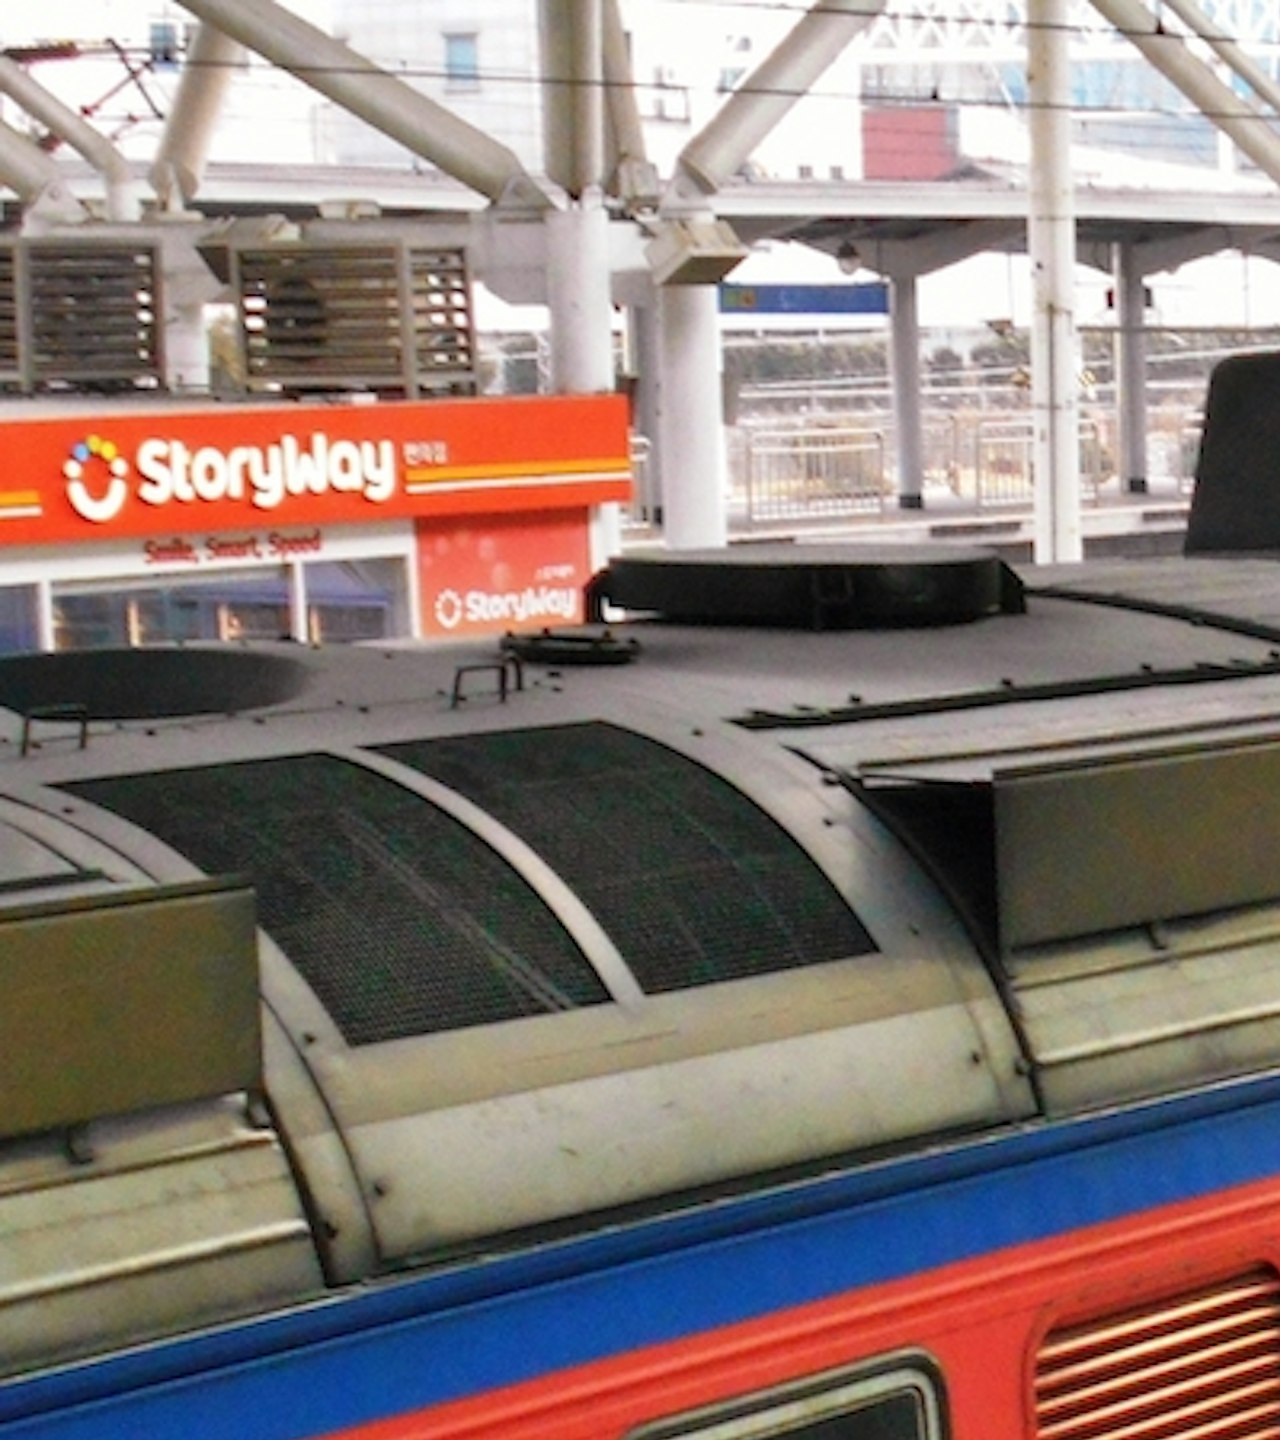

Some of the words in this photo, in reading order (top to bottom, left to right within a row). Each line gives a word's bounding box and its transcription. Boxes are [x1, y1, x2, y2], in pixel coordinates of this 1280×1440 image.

[136, 431, 395, 509] StoryWay
[206, 537, 262, 560] Smart,
[269, 528, 321, 561] Speed
[465, 586, 577, 622] StoryWay
